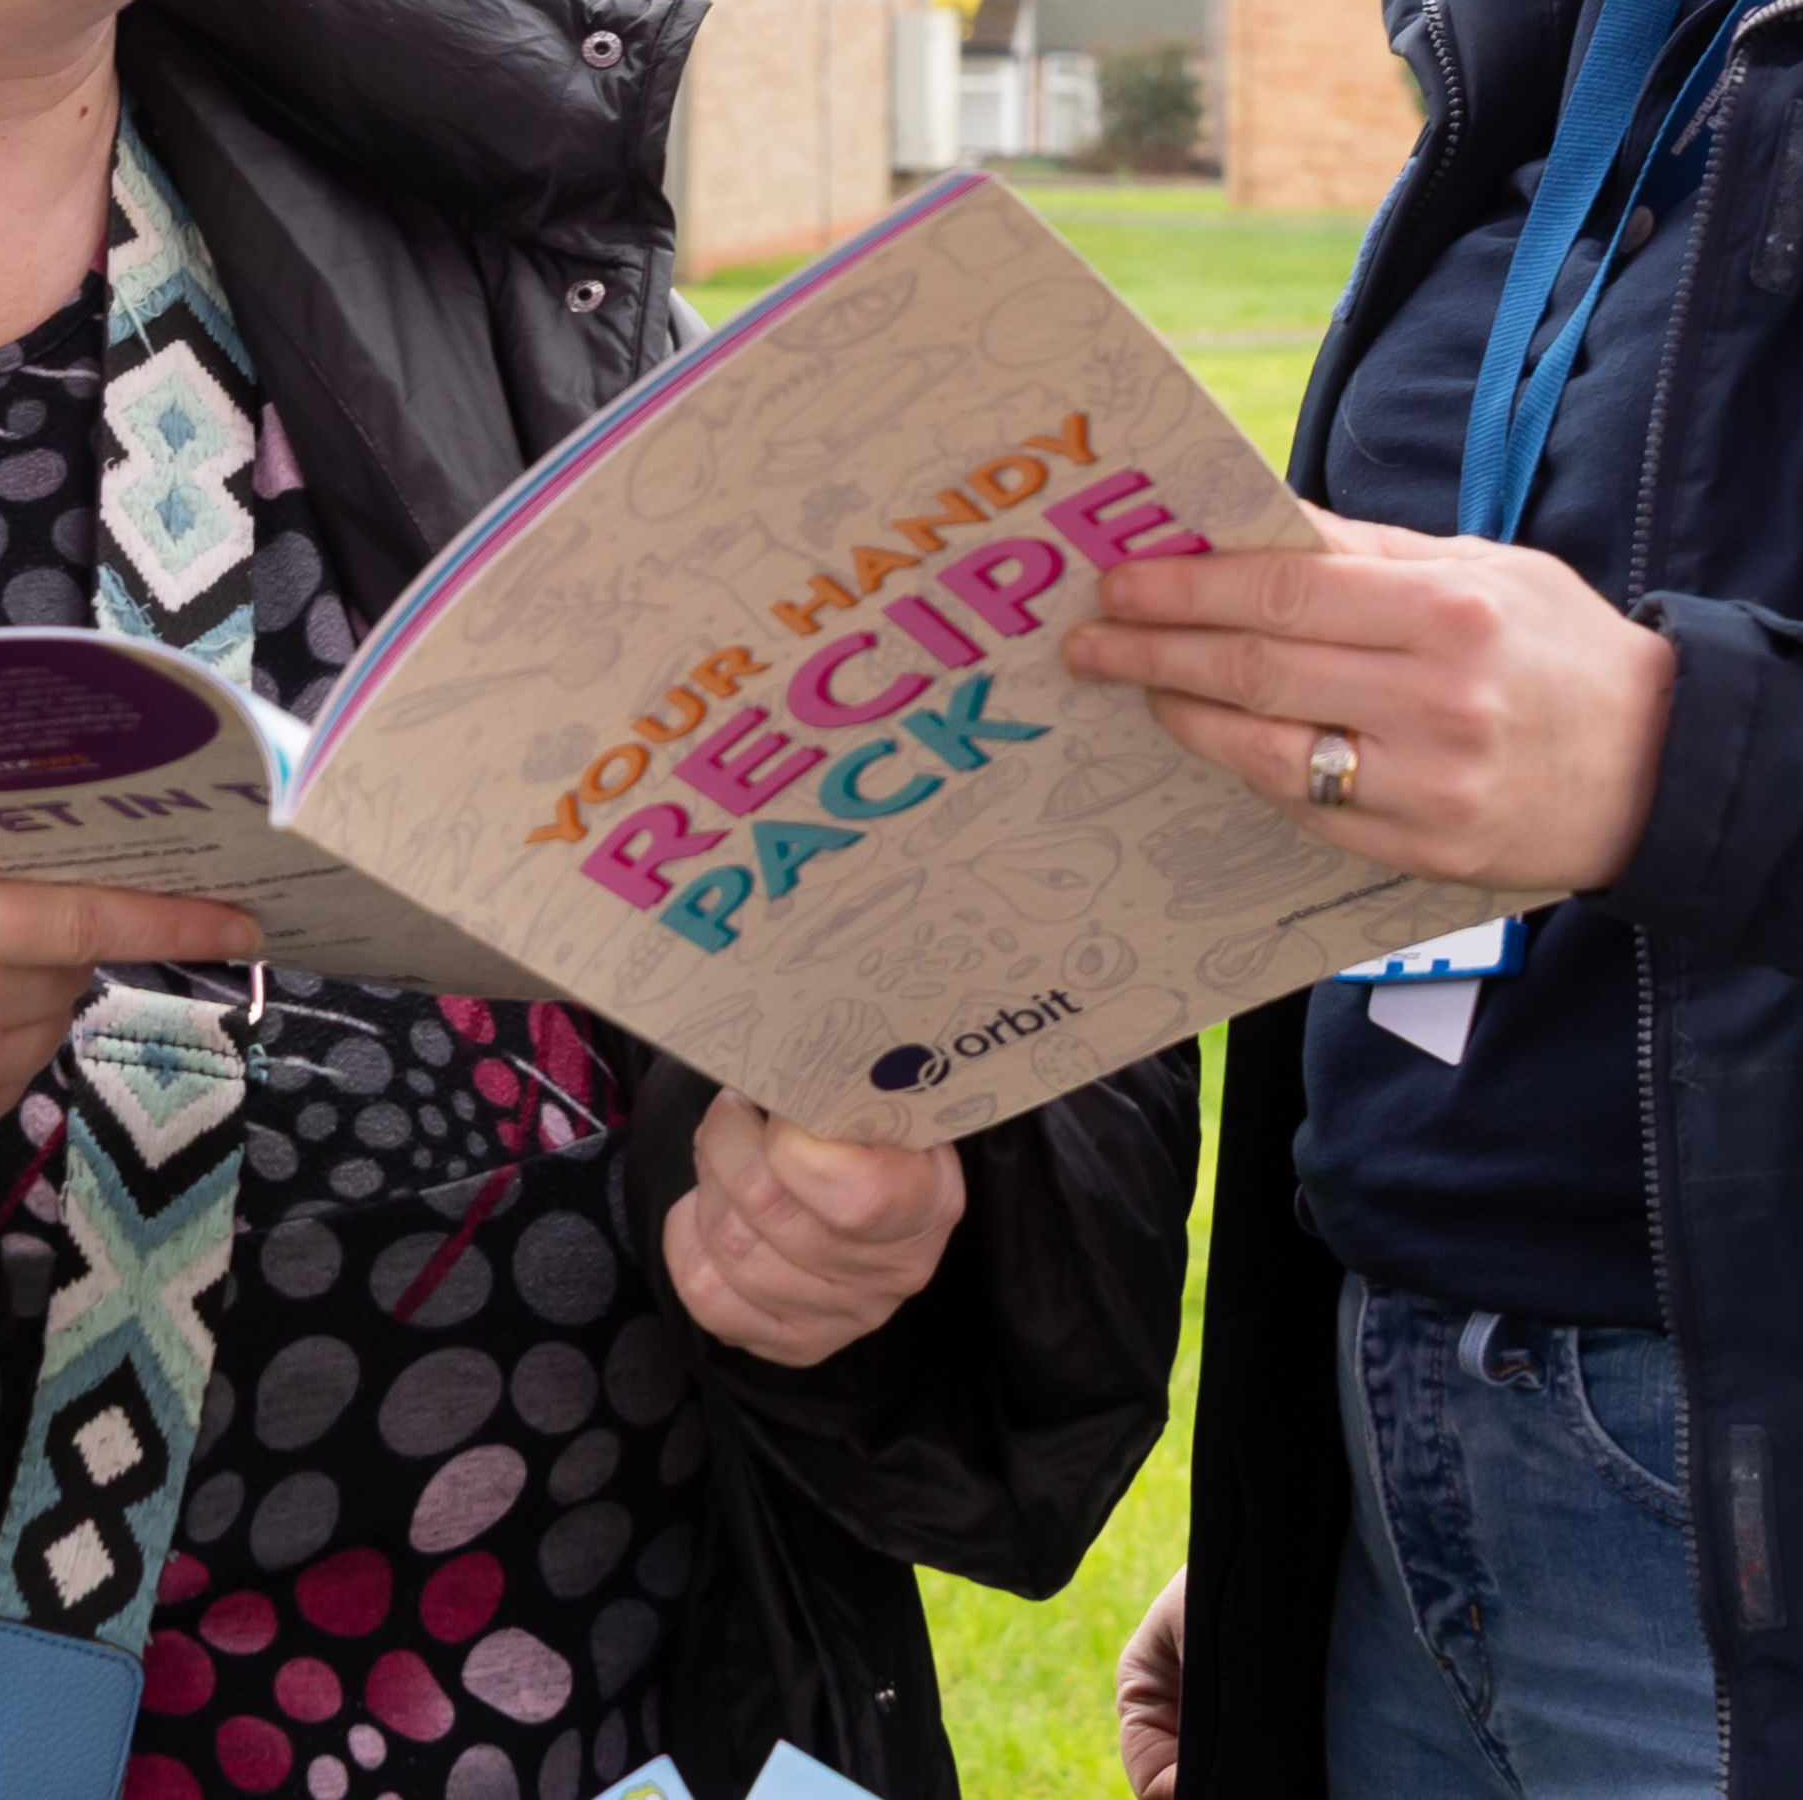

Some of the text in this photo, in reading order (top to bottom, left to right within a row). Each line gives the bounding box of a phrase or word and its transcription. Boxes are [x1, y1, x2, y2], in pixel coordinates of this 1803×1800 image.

[525, 410, 1099, 848] YOUR HANDY
[579, 467, 1213, 912] RECIPE
[97, 787, 213, 820] IN
[658, 672, 1053, 955] PACK
[953, 989, 1083, 1057] orbit
